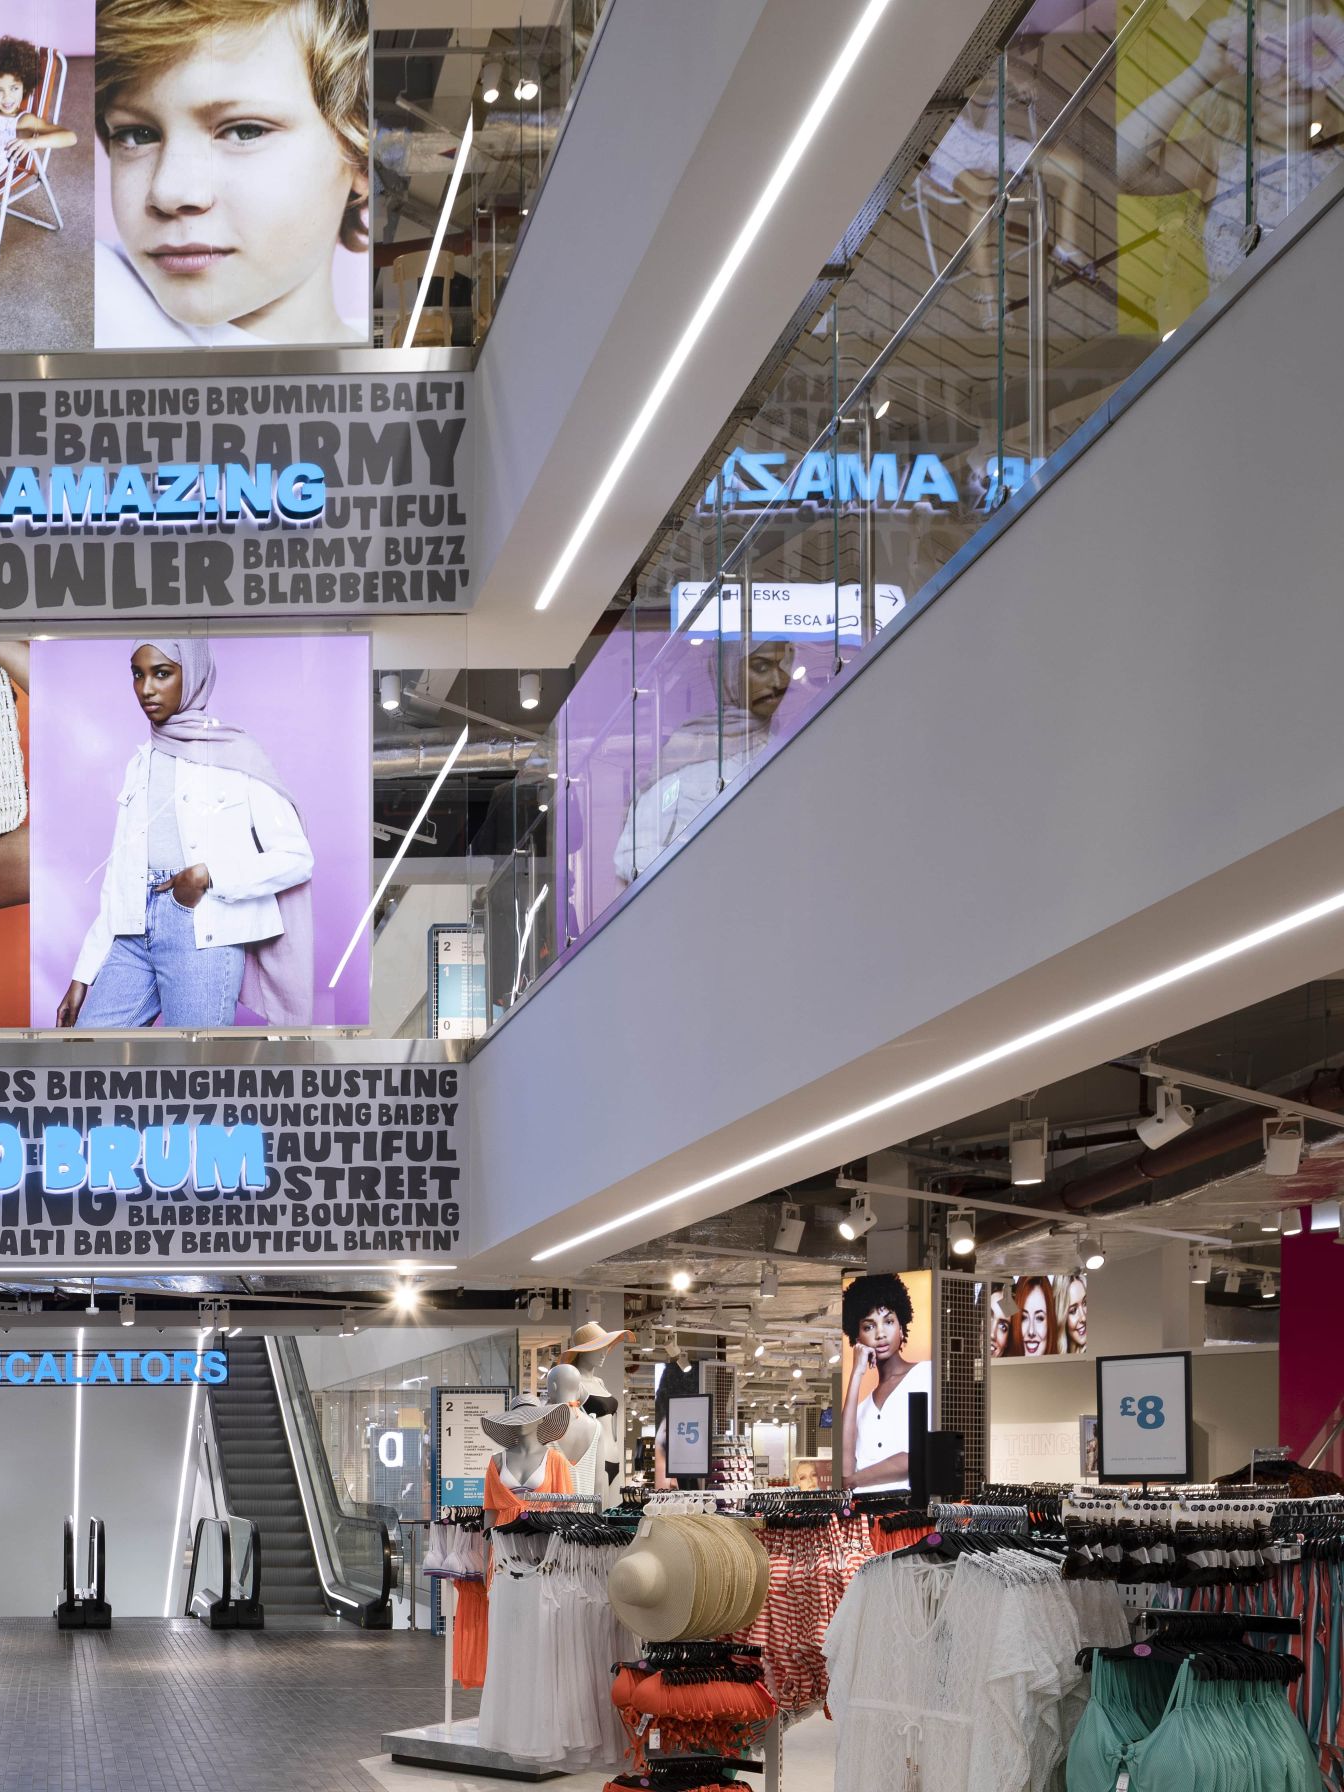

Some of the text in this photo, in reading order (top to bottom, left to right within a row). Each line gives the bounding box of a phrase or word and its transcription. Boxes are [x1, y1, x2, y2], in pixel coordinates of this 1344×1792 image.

[56, 387, 200, 419] BULLRING
[207, 383, 363, 416] BRUMMIE
[371, 380, 465, 412] BALTI
[57, 421, 201, 464] BALTI
[212, 418, 467, 488] BARMY
[258, 493, 466, 531] UTIFUL
[243, 538, 370, 570] BARMY
[385, 535, 467, 566] BUZZ
[243, 569, 470, 605] BLABBERIN'
[754, 590, 790, 601] ESKS
[443, 941, 452, 952] 2
[443, 966, 450, 977] 1
[443, 1020, 451, 1031] 0
[47, 1069, 294, 1100] BIRMINGHAM
[301, 1068, 458, 1099] BUSTLING
[114, 1103, 218, 1130] BUZZ
[223, 1102, 371, 1127] BOUNCING
[378, 1103, 459, 1127] BABBY
[43, 1124, 266, 1193] BRUM
[263, 1130, 457, 1163] EAUTIFUL
[128, 1203, 287, 1227] BLABBERIN'
[292, 1202, 460, 1227] BOUNCING
[74, 1229, 175, 1256] BABBY
[181, 1229, 338, 1254] BEAUTIFUL
[343, 1229, 459, 1252] BLARTIN'
[445, 1401, 454, 1412] 2
[1120, 1395, 1165, 1430] £8
[445, 1426, 452, 1437] 1
[677, 1421, 700, 1445] £5
[445, 1480, 454, 1491] 0
